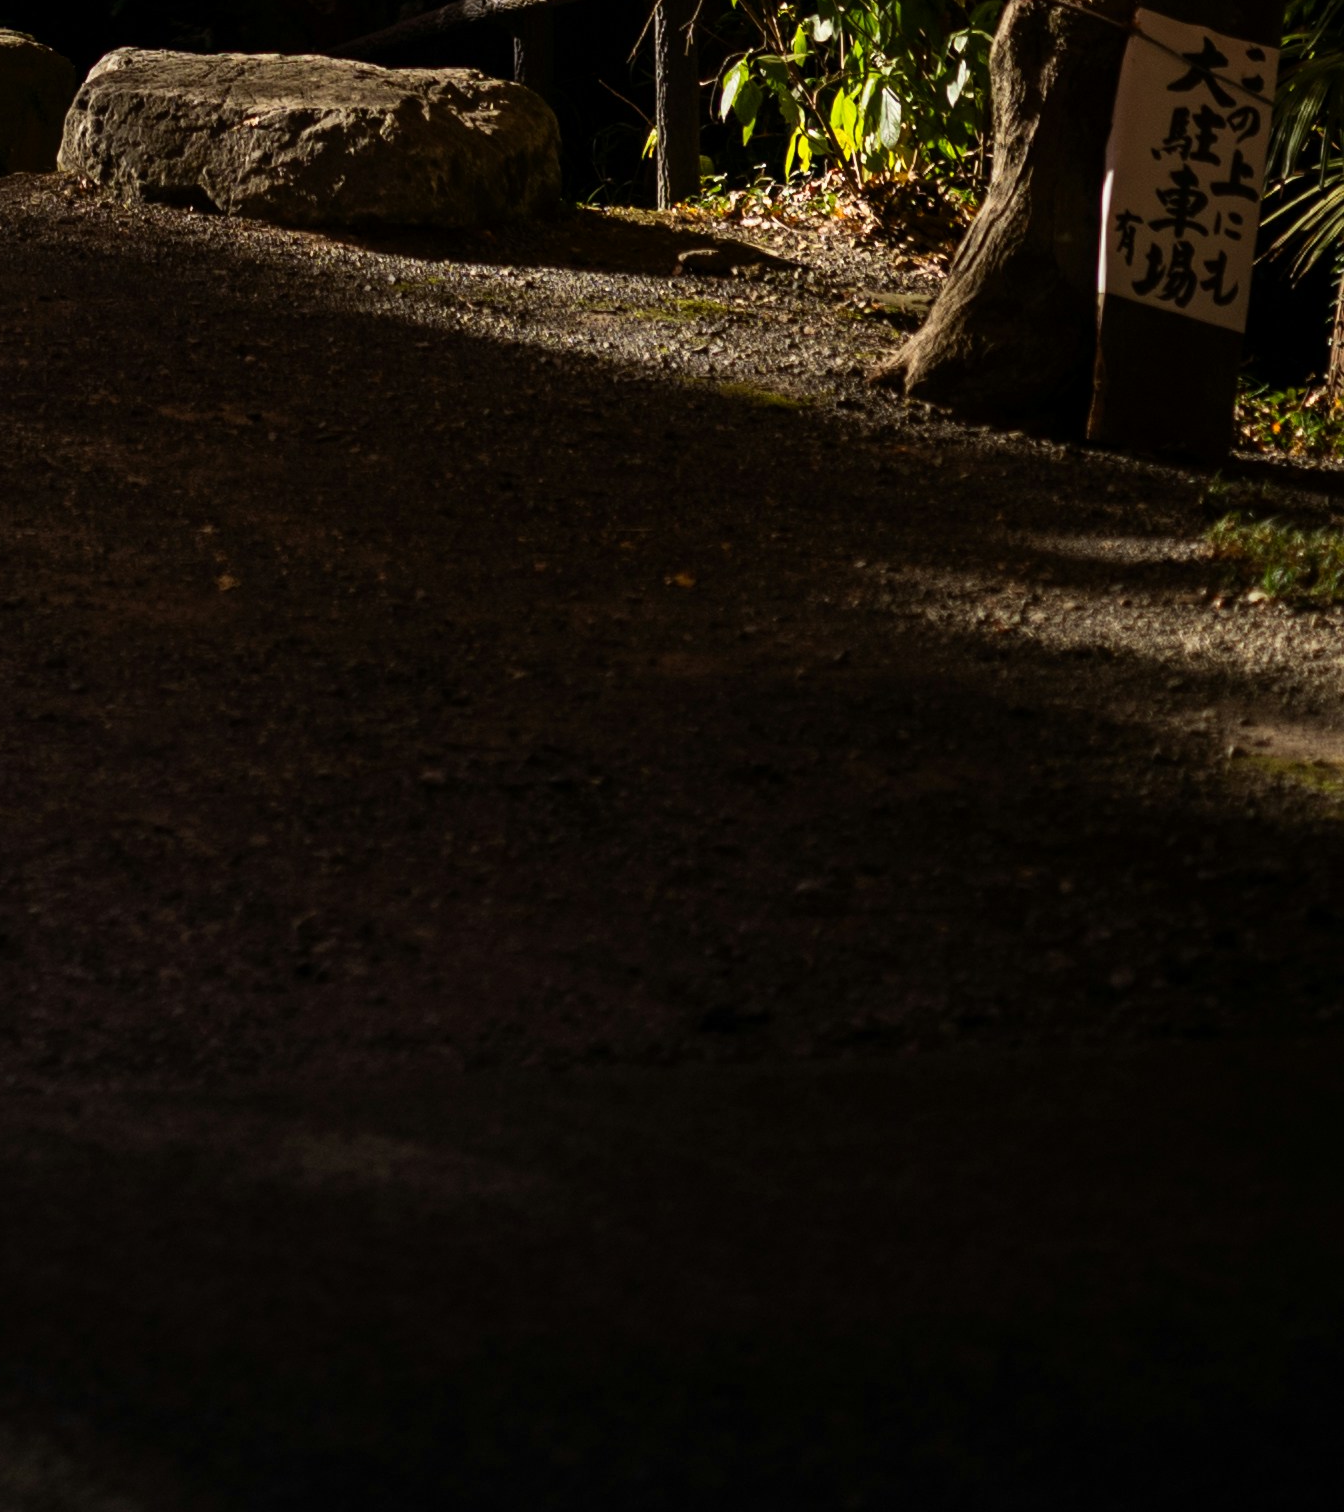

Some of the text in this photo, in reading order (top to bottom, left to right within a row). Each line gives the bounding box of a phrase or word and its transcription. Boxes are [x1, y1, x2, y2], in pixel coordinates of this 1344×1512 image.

[1115, 209, 1143, 266] 有
[1132, 35, 1236, 308] 大駐車場
